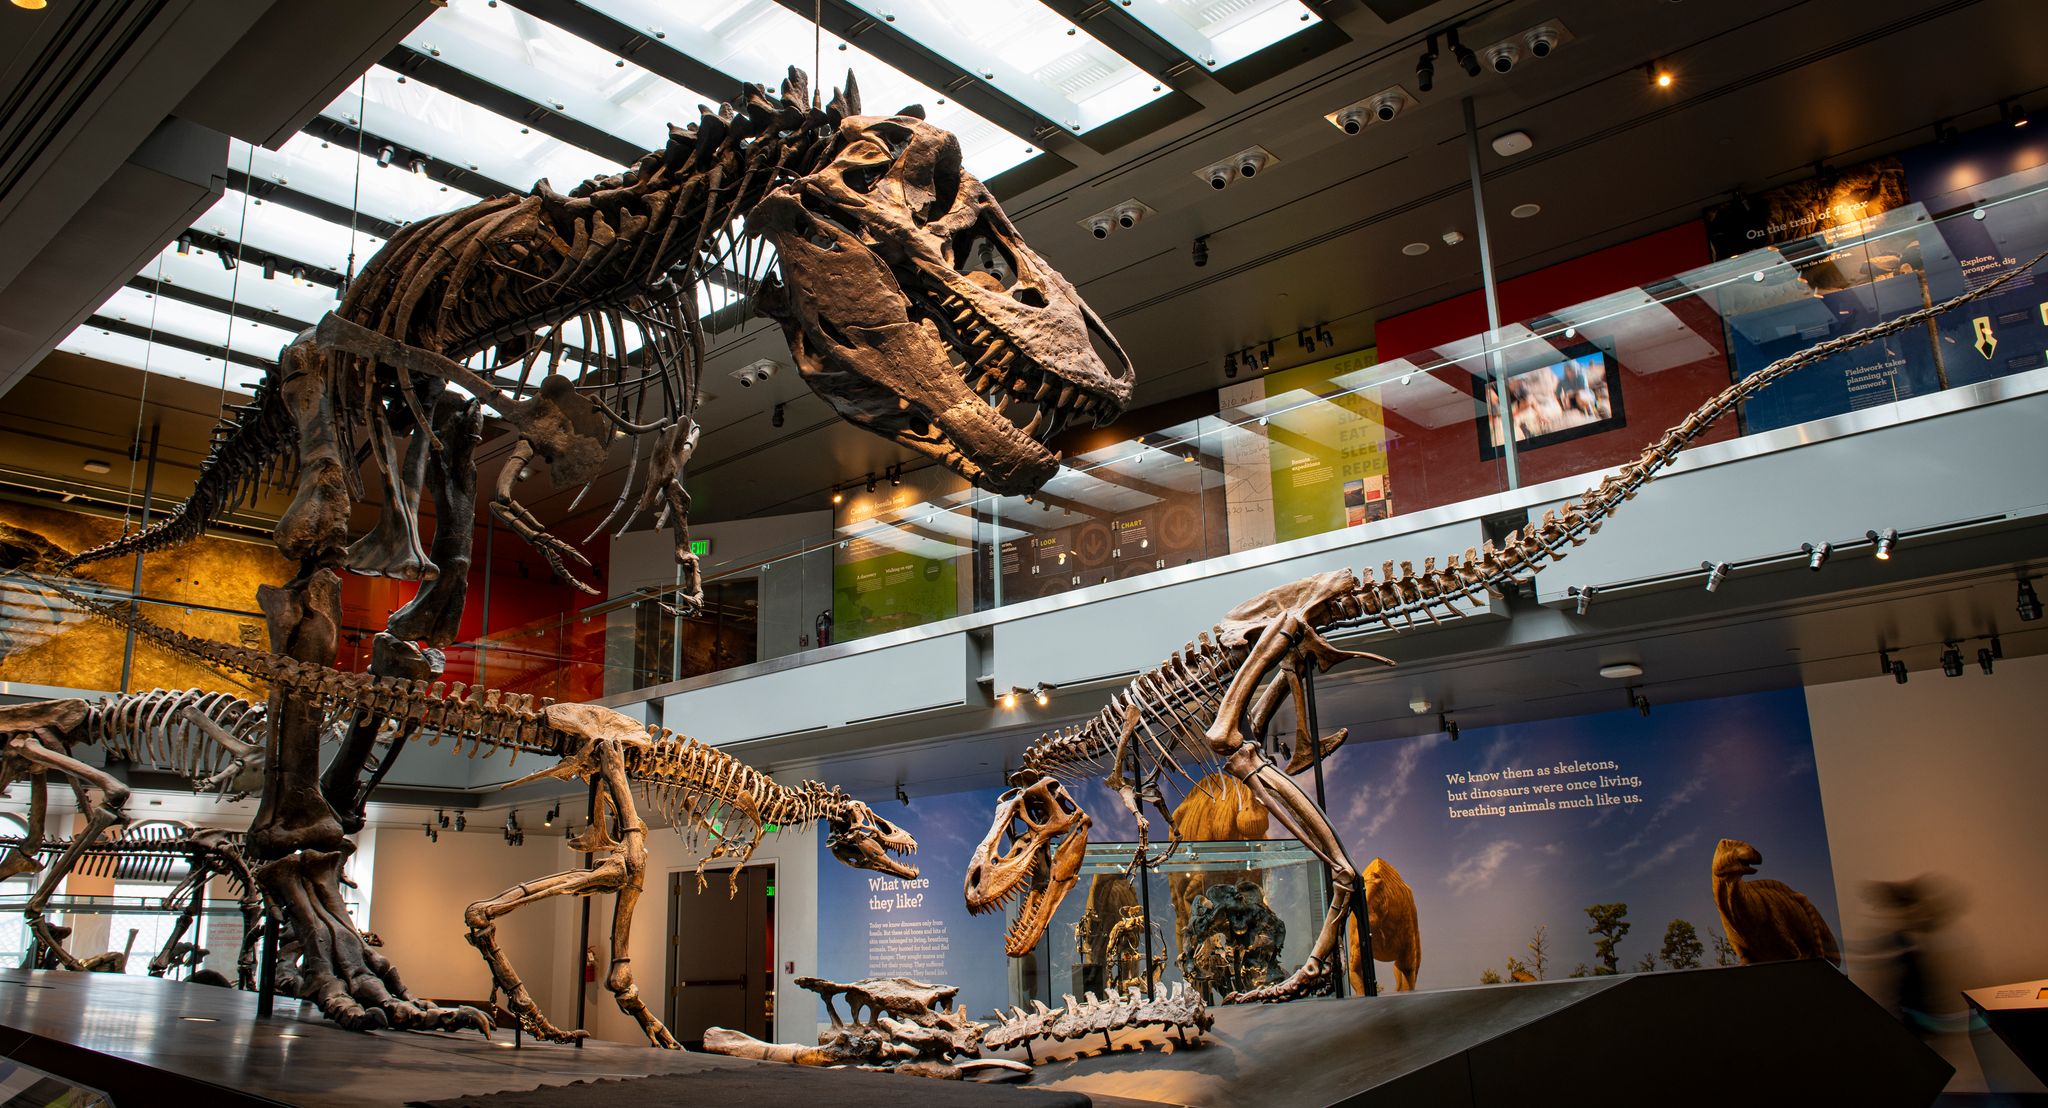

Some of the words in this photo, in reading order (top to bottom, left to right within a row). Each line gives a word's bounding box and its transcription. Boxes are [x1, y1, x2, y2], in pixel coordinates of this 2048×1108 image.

[1746, 230, 1765, 240] On
[1767, 223, 1787, 235] the
[1790, 212, 1816, 228] trail
[1818, 208, 1831, 220] of
[1960, 256, 1995, 266] Explore,
[1962, 261, 2001, 276] prospect,
[2002, 257, 2016, 265] dig
[1845, 362, 1884, 376] Fieldwork
[1885, 359, 1906, 368] takes
[1846, 372, 1881, 386] planning
[1883, 368, 1898, 376] and
[1848, 378, 1887, 392] teamwork
[1340, 425, 1369, 442] EAT
[1121, 519, 1143, 529] CHART
[692, 542, 707, 555] EXIT
[1040, 538, 1057, 546] LOOK
[1446, 774, 1465, 785] We
[1468, 772, 1500, 783] know
[1503, 767, 1534, 780] them
[1537, 768, 1550, 776] as
[1553, 760, 1619, 774] skeletons,
[1448, 790, 1467, 802] but
[1470, 785, 1530, 800] dinosaurs
[1532, 782, 1563, 794] were
[1566, 779, 1597, 790] once
[1599, 775, 1642, 788] living,
[1449, 806, 1506, 818] breathing
[1509, 798, 1555, 813] animals
[1558, 795, 1594, 809] much
[1596, 793, 1621, 806] like
[1623, 794, 1643, 804] us.
[869, 876, 898, 891] What
[901, 878, 929, 889] were
[869, 895, 894, 912] they
[896, 893, 923, 908] like?
